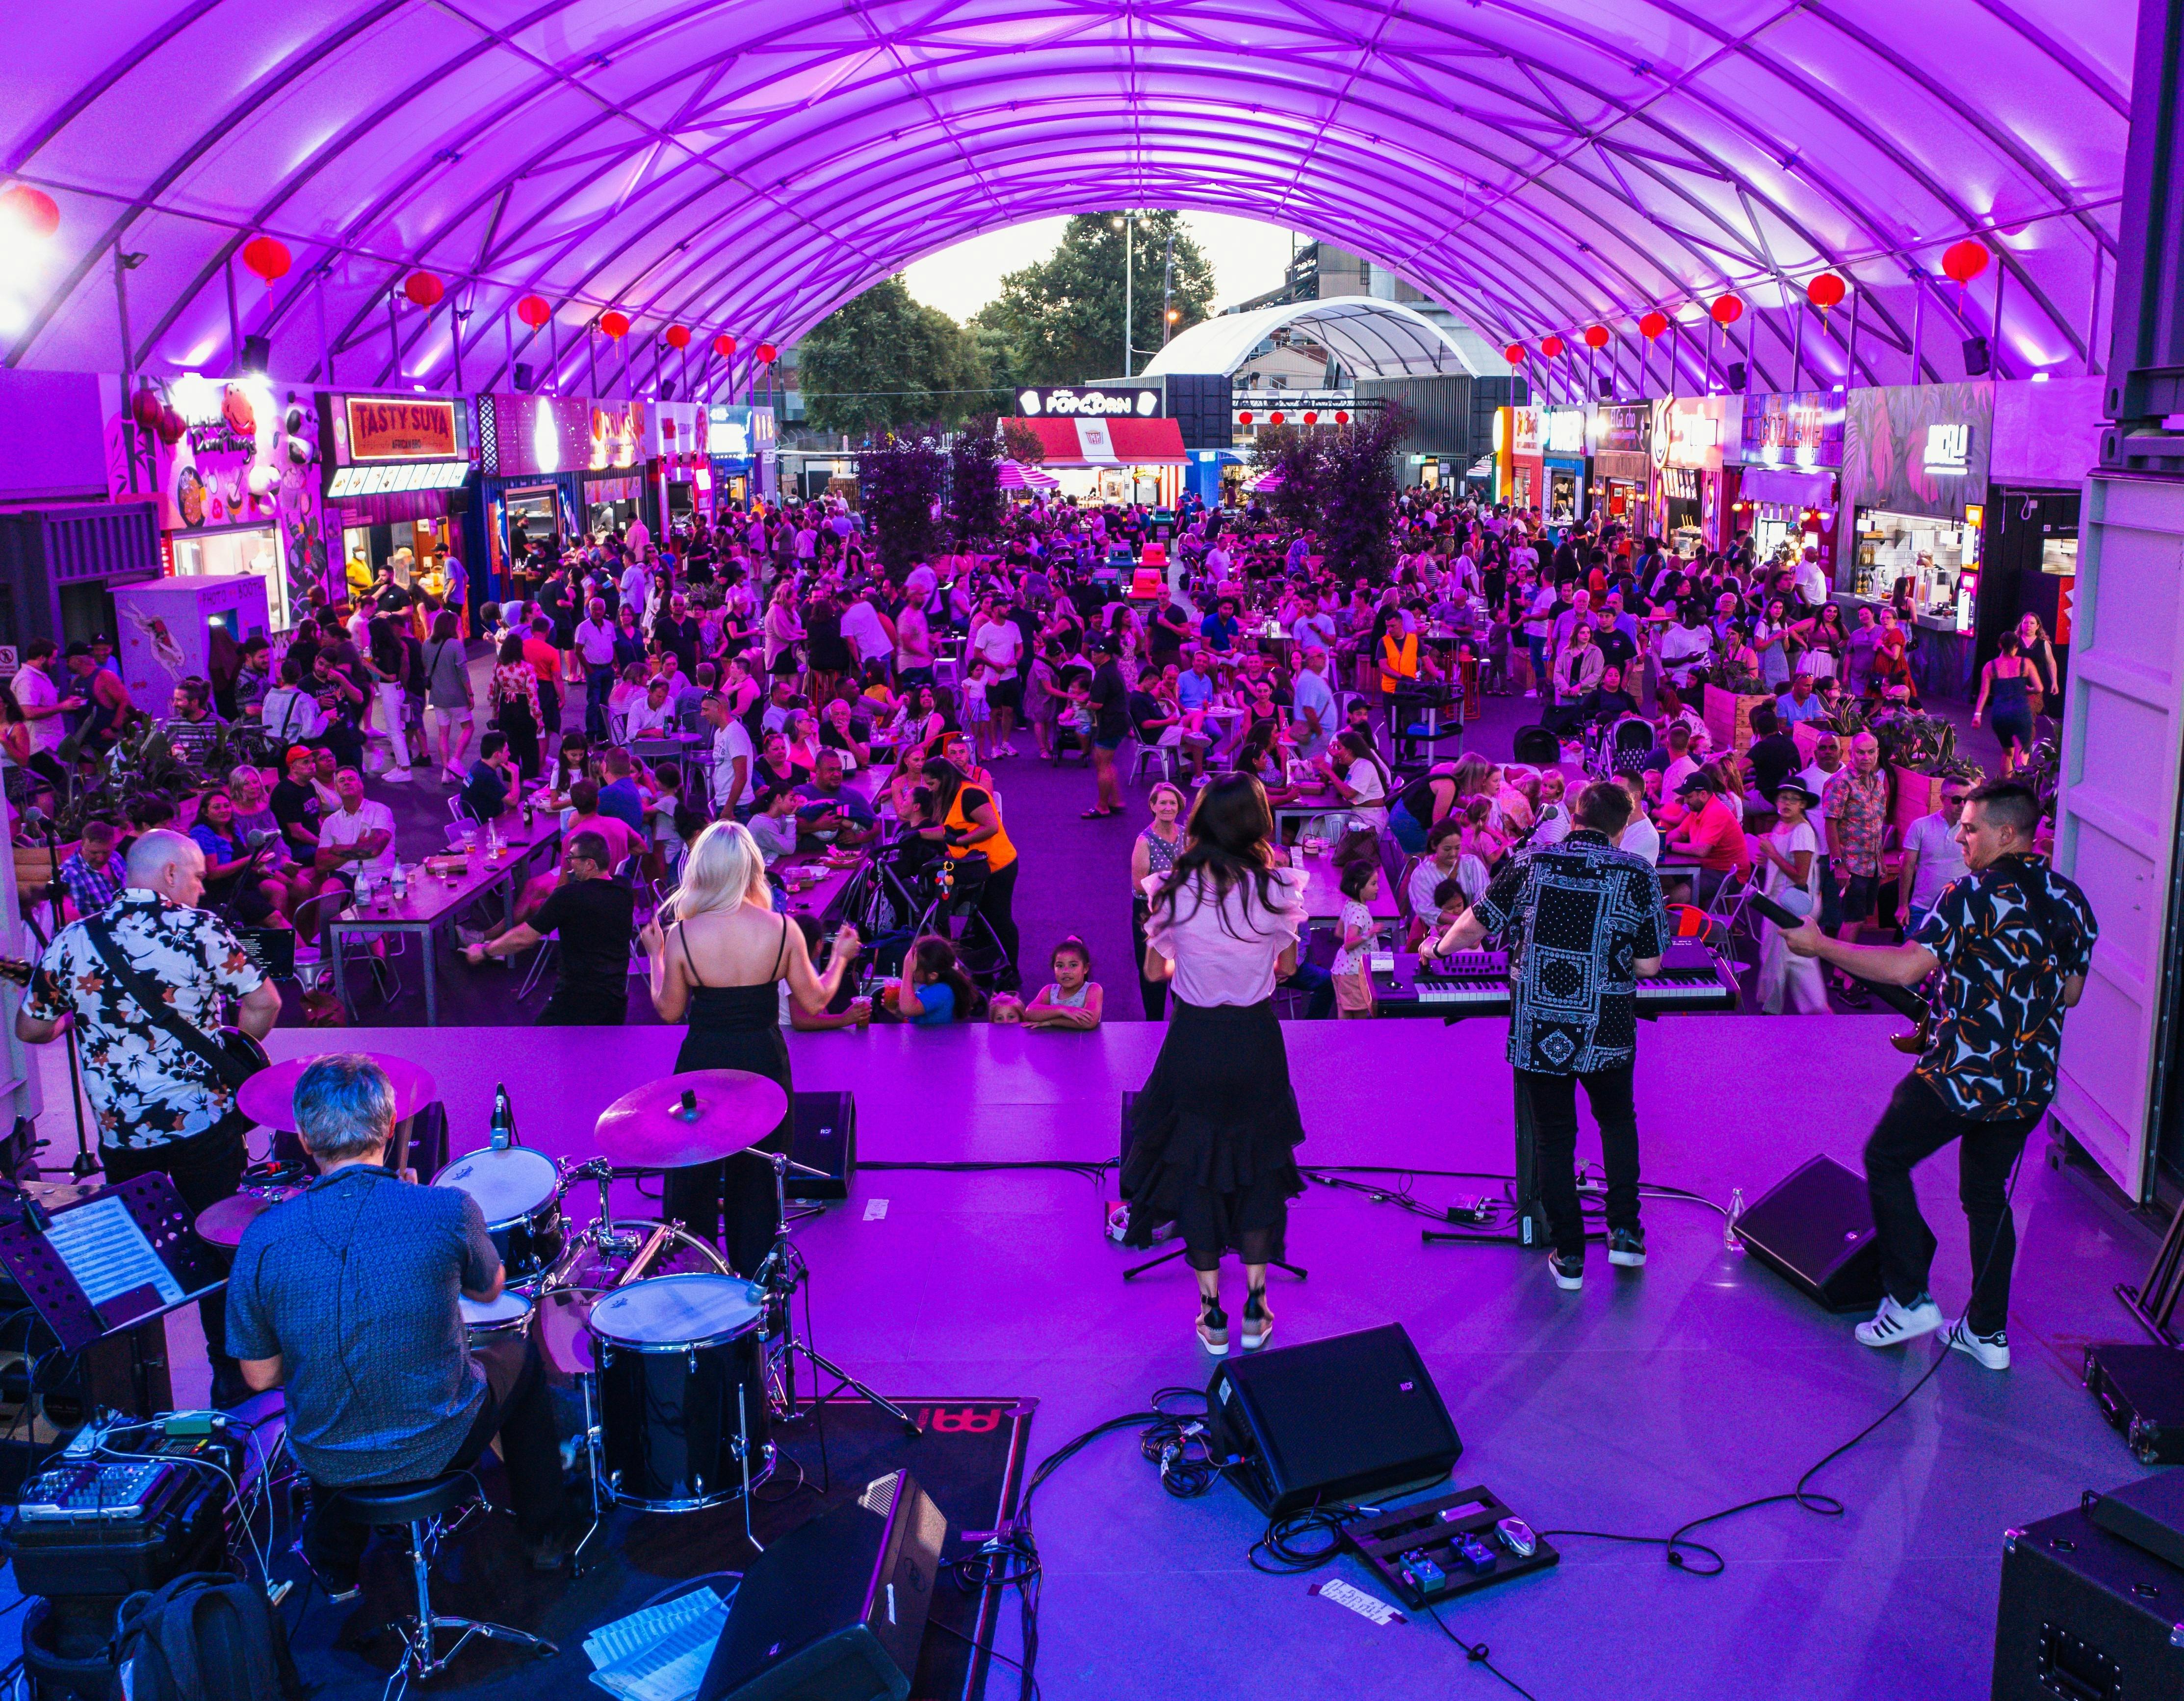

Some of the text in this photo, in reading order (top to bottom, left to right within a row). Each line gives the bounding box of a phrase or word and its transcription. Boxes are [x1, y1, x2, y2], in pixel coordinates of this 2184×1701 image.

[1046, 392, 1131, 415] POPCORN
[356, 404, 449, 439] TASTY SUYA
[1616, 407, 1636, 428] Gacho
[202, 582, 263, 606] PHOTO BOOTH
[1400, 1382, 1413, 1391] RCF
